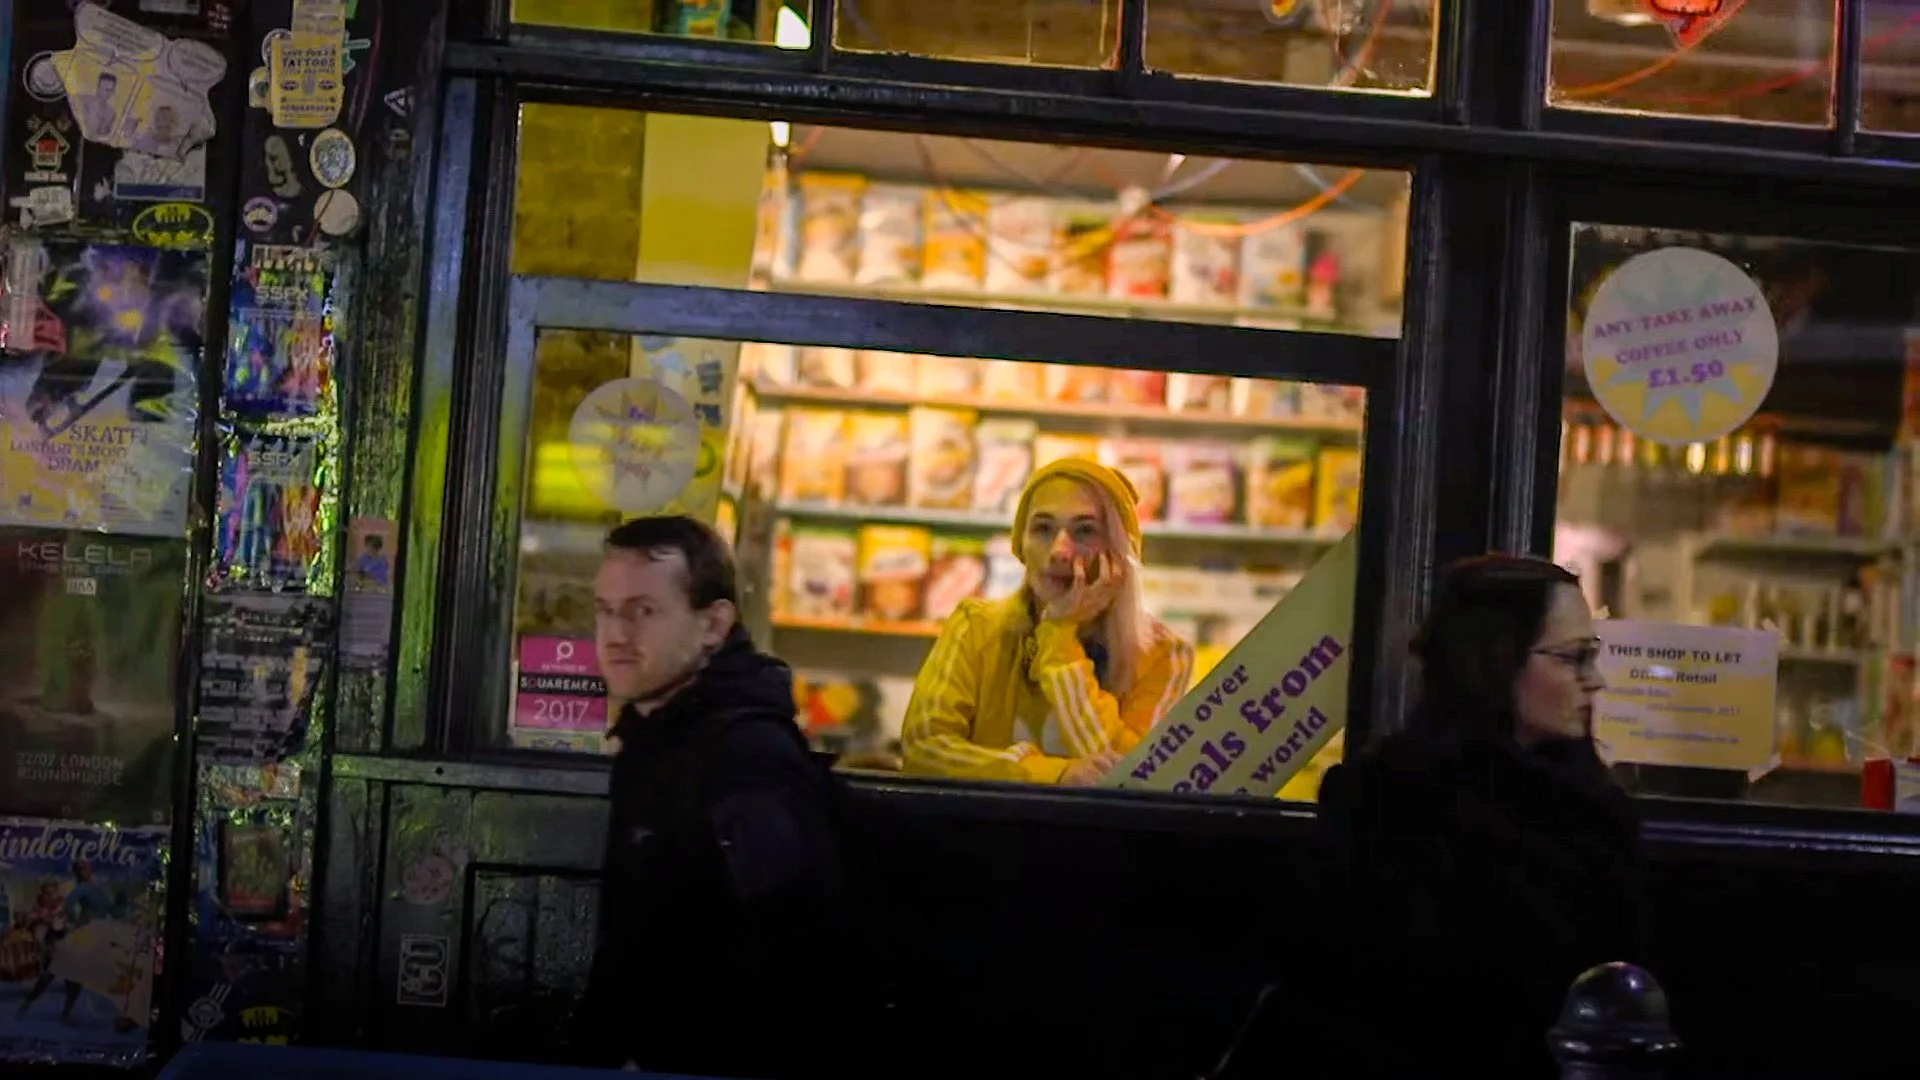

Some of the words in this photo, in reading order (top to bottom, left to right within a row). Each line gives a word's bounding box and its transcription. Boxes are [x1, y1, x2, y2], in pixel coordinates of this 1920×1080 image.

[283, 58, 336, 68] TATTOOS
[1593, 318, 1634, 339] ANY
[1641, 309, 1694, 330] TAKE
[1701, 298, 1758, 321] AWAY
[1615, 338, 1687, 365] COFFEE
[1694, 328, 1746, 351] ONLY
[1647, 360, 1725, 389] £1.50
[17, 542, 152, 566] KELELA
[1608, 645, 1643, 657] THIS
[1647, 647, 1687, 661] SHOP
[1692, 651, 1711, 663] TO
[1715, 653, 1742, 664] LET
[520, 677, 605, 692] SQUAREMEAL
[1239, 634, 1344, 733] from
[1675, 673, 1718, 685] Retail
[533, 697, 590, 725] 2017
[1131, 722, 1194, 781] with
[1195, 664, 1247, 722] over
[1251, 706, 1328, 783] world
[60, 753, 125, 771] LONDON
[17, 766, 124, 787] ROUNDHOUSE
[0, 820, 142, 869] inderella
